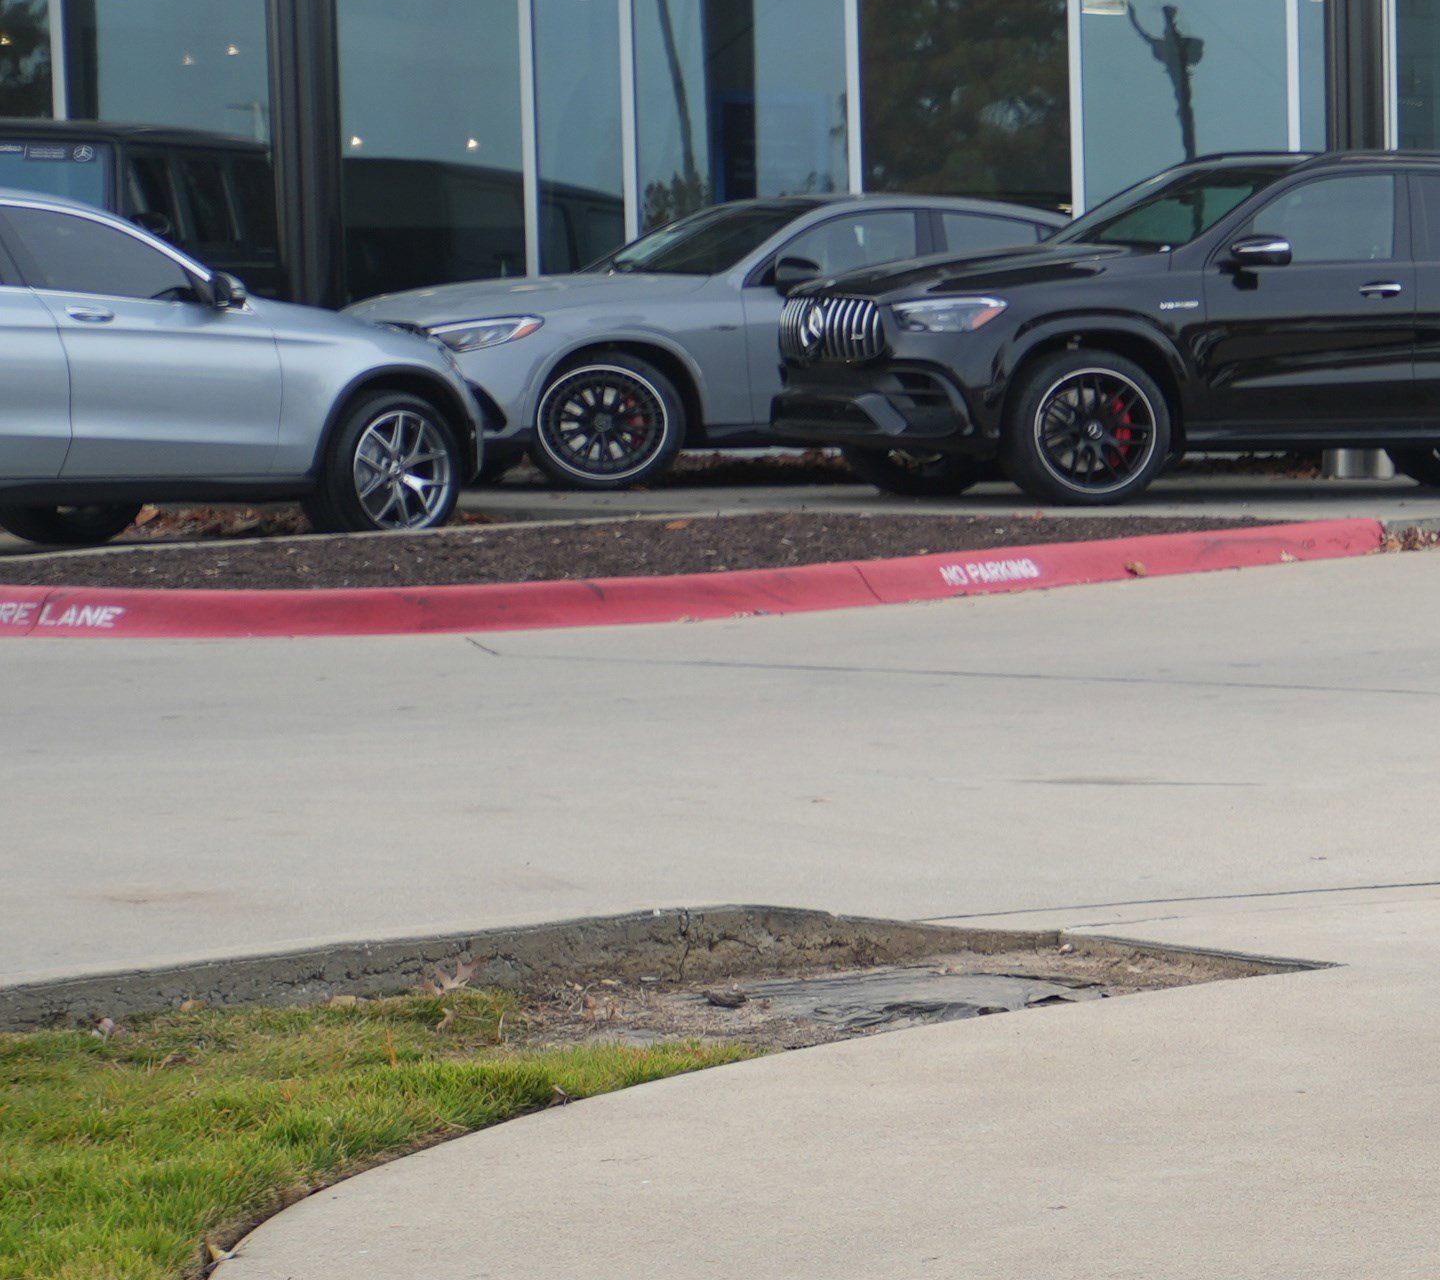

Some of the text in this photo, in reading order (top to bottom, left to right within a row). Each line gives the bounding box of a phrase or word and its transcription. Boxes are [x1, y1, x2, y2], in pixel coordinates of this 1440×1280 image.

[939, 558, 1040, 586] NO PARKING
[0, 601, 126, 629] RE LANE
